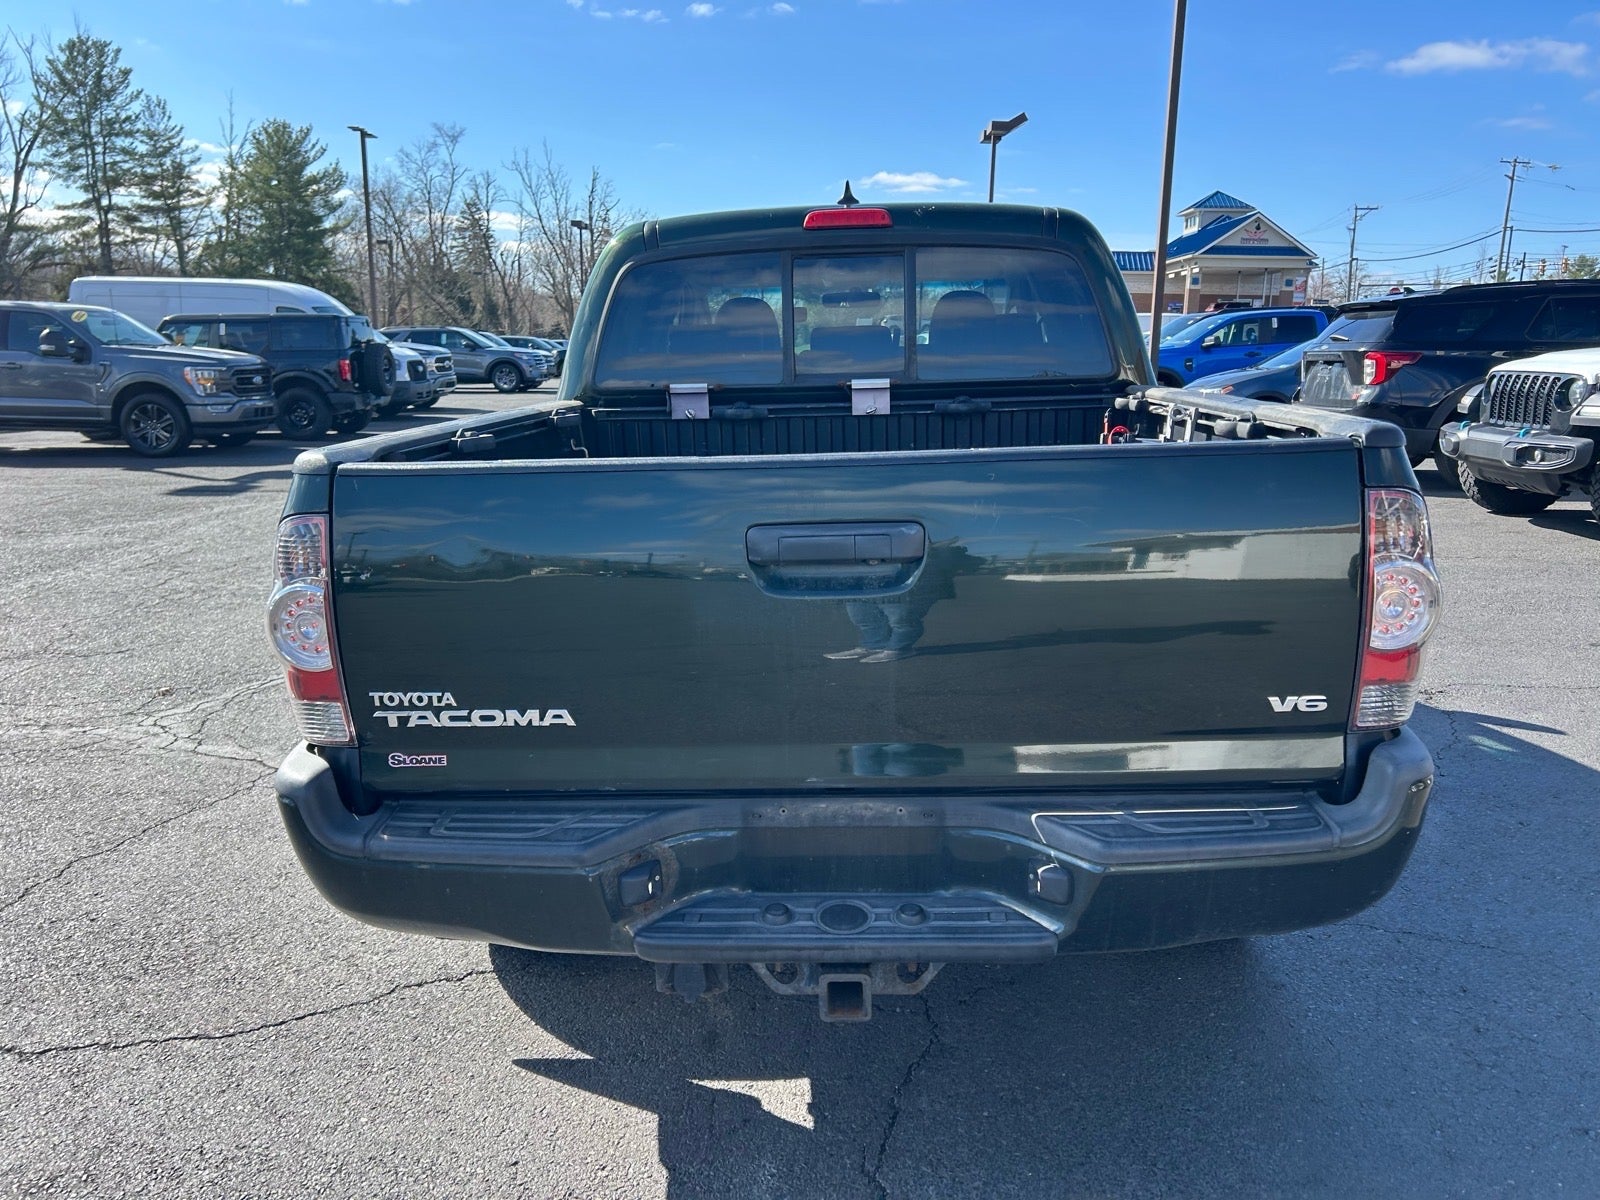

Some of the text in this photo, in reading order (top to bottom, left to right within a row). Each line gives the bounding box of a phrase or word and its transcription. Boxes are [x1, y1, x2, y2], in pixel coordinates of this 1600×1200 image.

[369, 692, 457, 707] TOYOTA
[1267, 695, 1328, 712] V6
[373, 709, 576, 727] TACOMA
